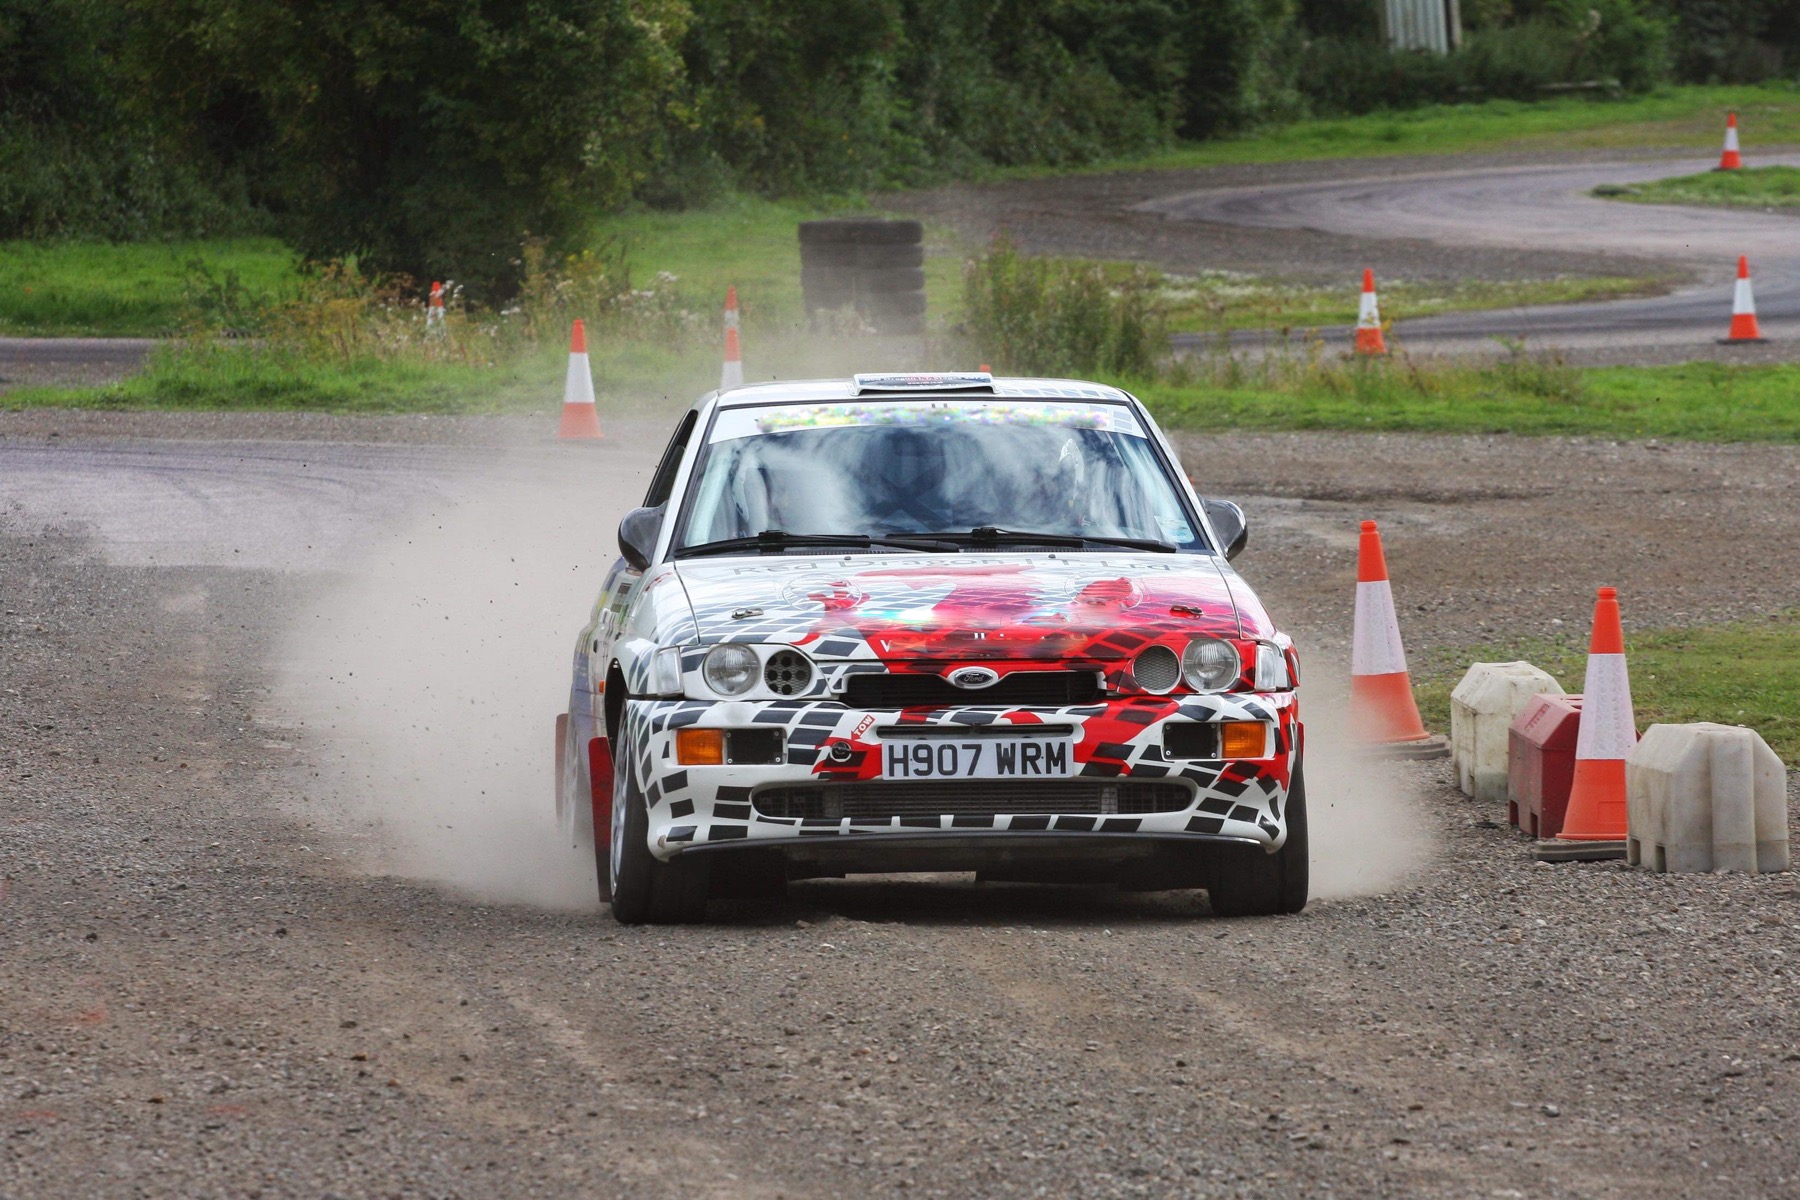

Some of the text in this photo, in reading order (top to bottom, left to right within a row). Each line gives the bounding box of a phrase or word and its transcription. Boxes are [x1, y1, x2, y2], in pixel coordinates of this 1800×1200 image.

[733, 562, 818, 576] Red
[838, 559, 1004, 568] Dragon
[963, 672, 985, 682] Ford
[853, 715, 873, 736] TOW
[888, 741, 1067, 777] H907 WRM
